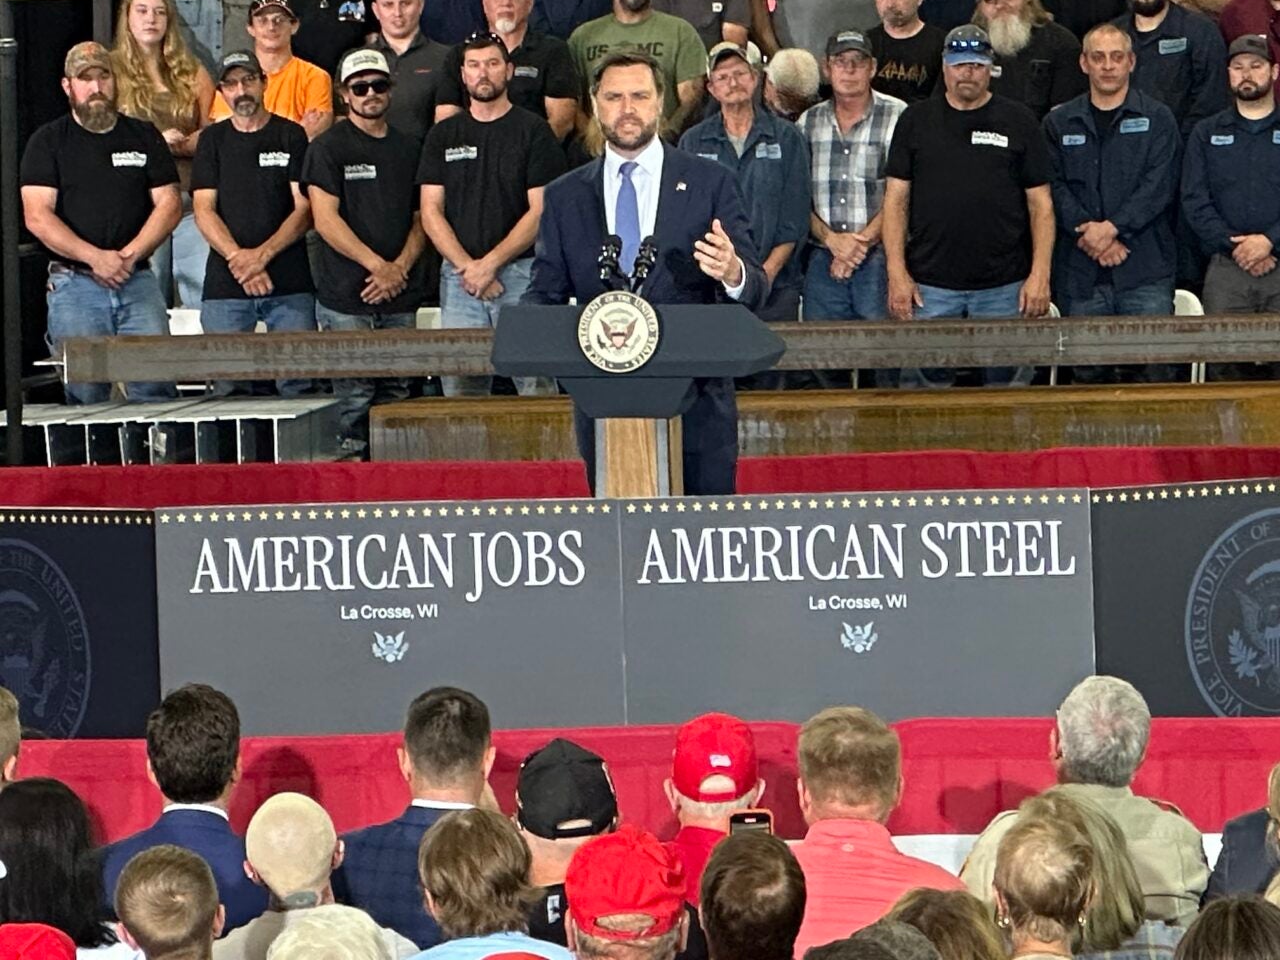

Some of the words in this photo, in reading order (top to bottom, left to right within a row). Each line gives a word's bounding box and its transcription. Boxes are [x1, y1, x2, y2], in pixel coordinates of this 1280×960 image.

[637, 524, 906, 584] AMERICAN
[921, 520, 1076, 579] STEEL
[1250, 522, 1272, 540] OF
[189, 533, 456, 593] AMERICAN
[465, 530, 586, 602] JOBS
[40, 564, 84, 651] UNITED
[341, 605, 358, 620] La
[360, 604, 415, 620] Crosse,
[417, 603, 438, 618] WI
[809, 595, 826, 610] La
[828, 594, 883, 611] Crosse,
[886, 593, 907, 609] WI
[1192, 537, 1241, 665] PRESIDENT
[1208, 673, 1243, 717] VICE
